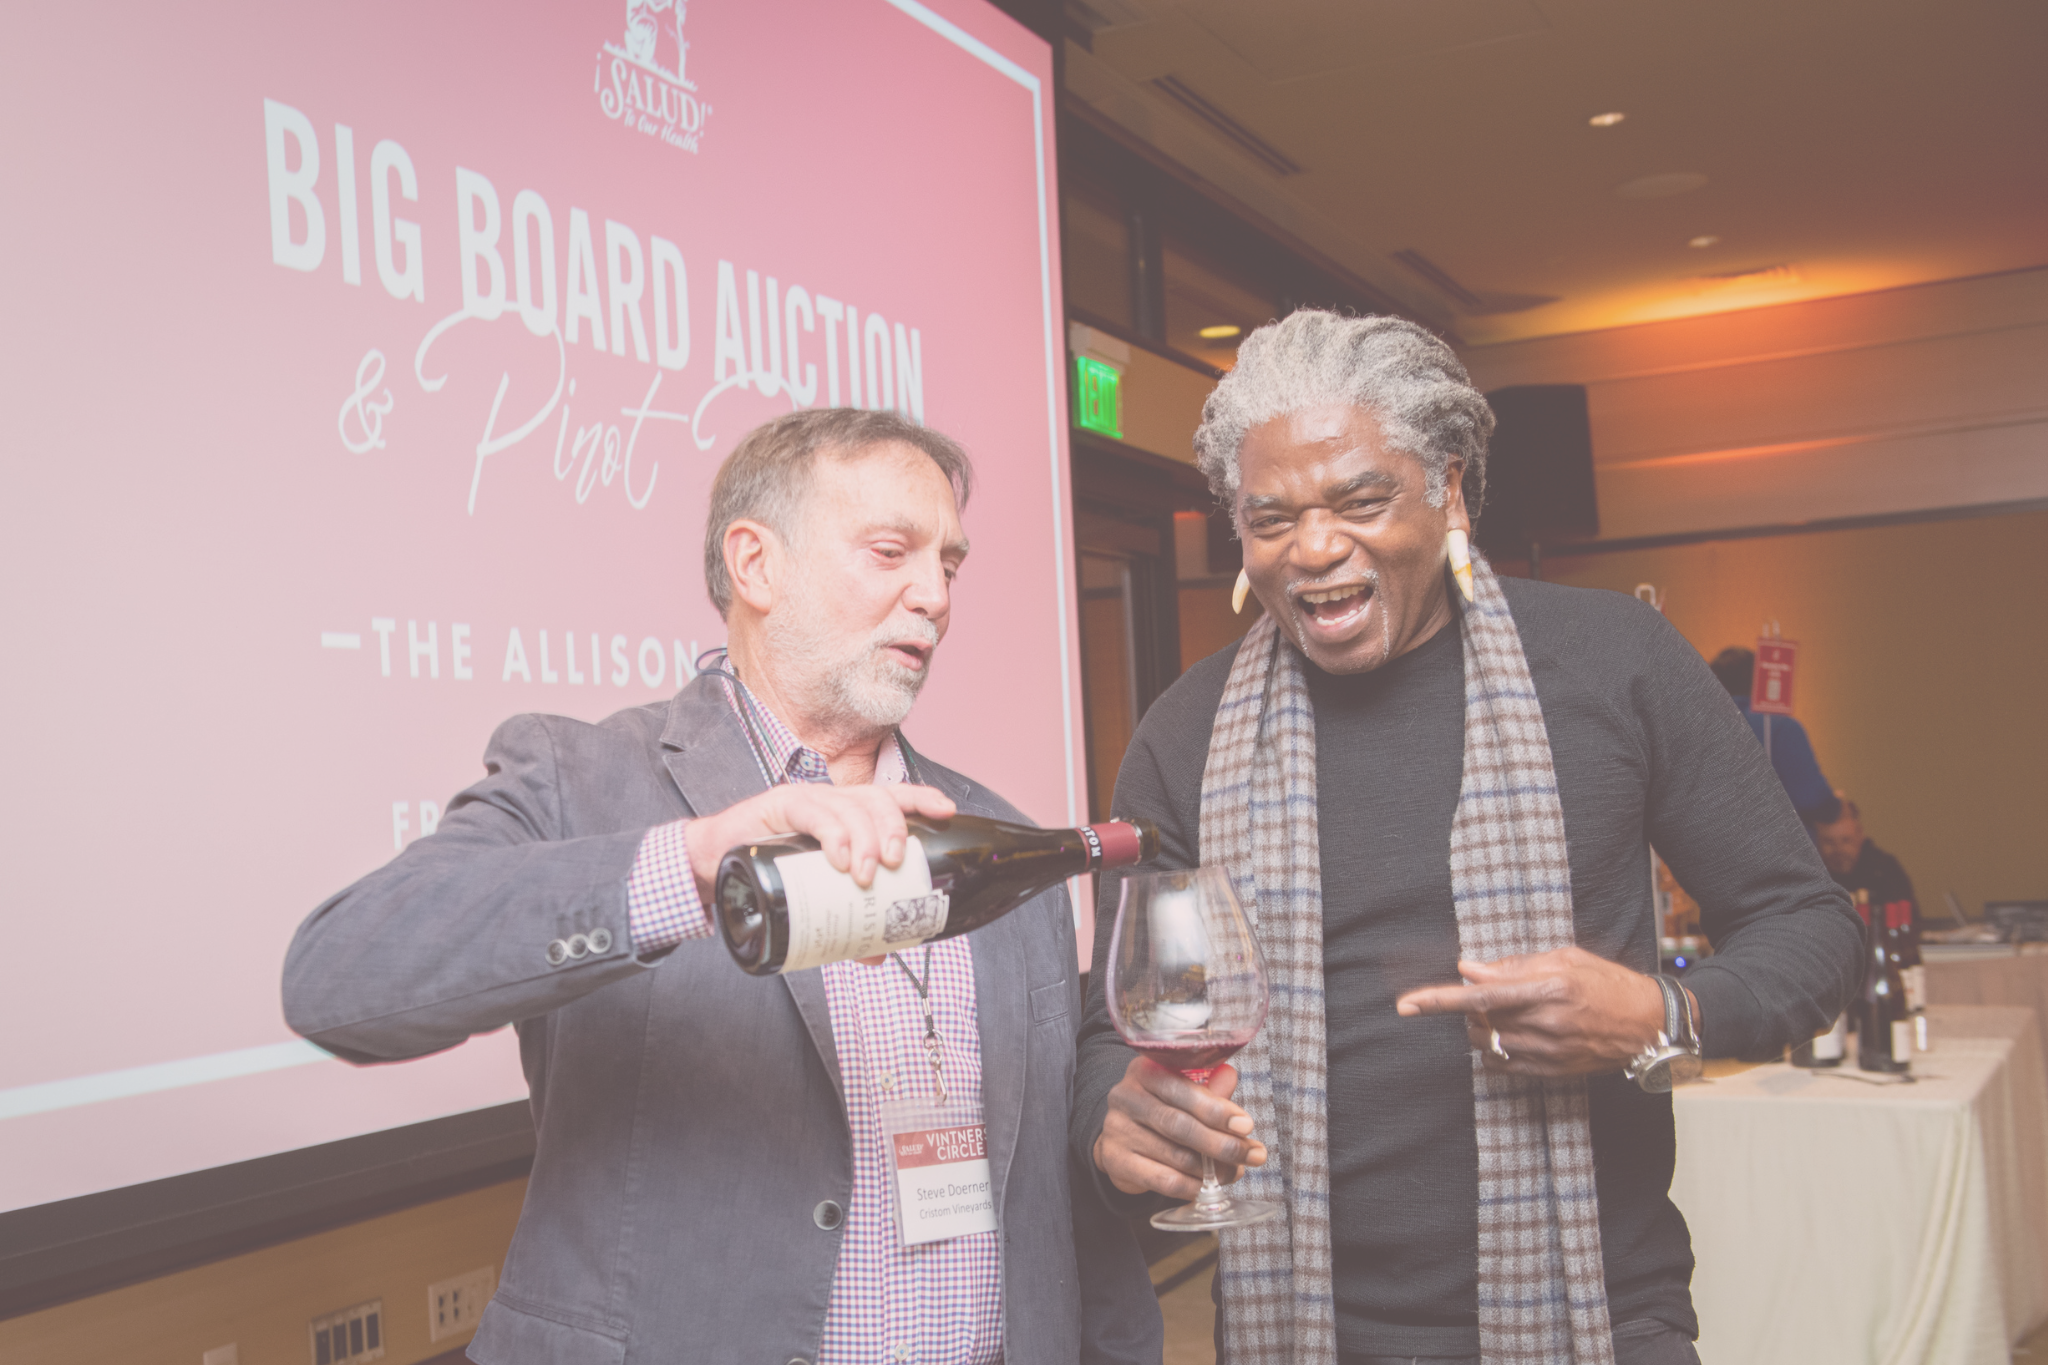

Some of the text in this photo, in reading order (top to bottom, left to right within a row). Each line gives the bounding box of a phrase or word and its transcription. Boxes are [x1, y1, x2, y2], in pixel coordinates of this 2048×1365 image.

[660, 124, 699, 155] Health
[264, 97, 925, 427] BIG BOARD AUCTION
[338, 348, 394, 454] &
[414, 302, 690, 517] Pinot
[502, 627, 698, 690] ALLISON
[937, 1142, 985, 1161] CIRCLE
[917, 1181, 989, 1201] Steve Doerner
[920, 1200, 992, 1220] Cristom Vineyards
